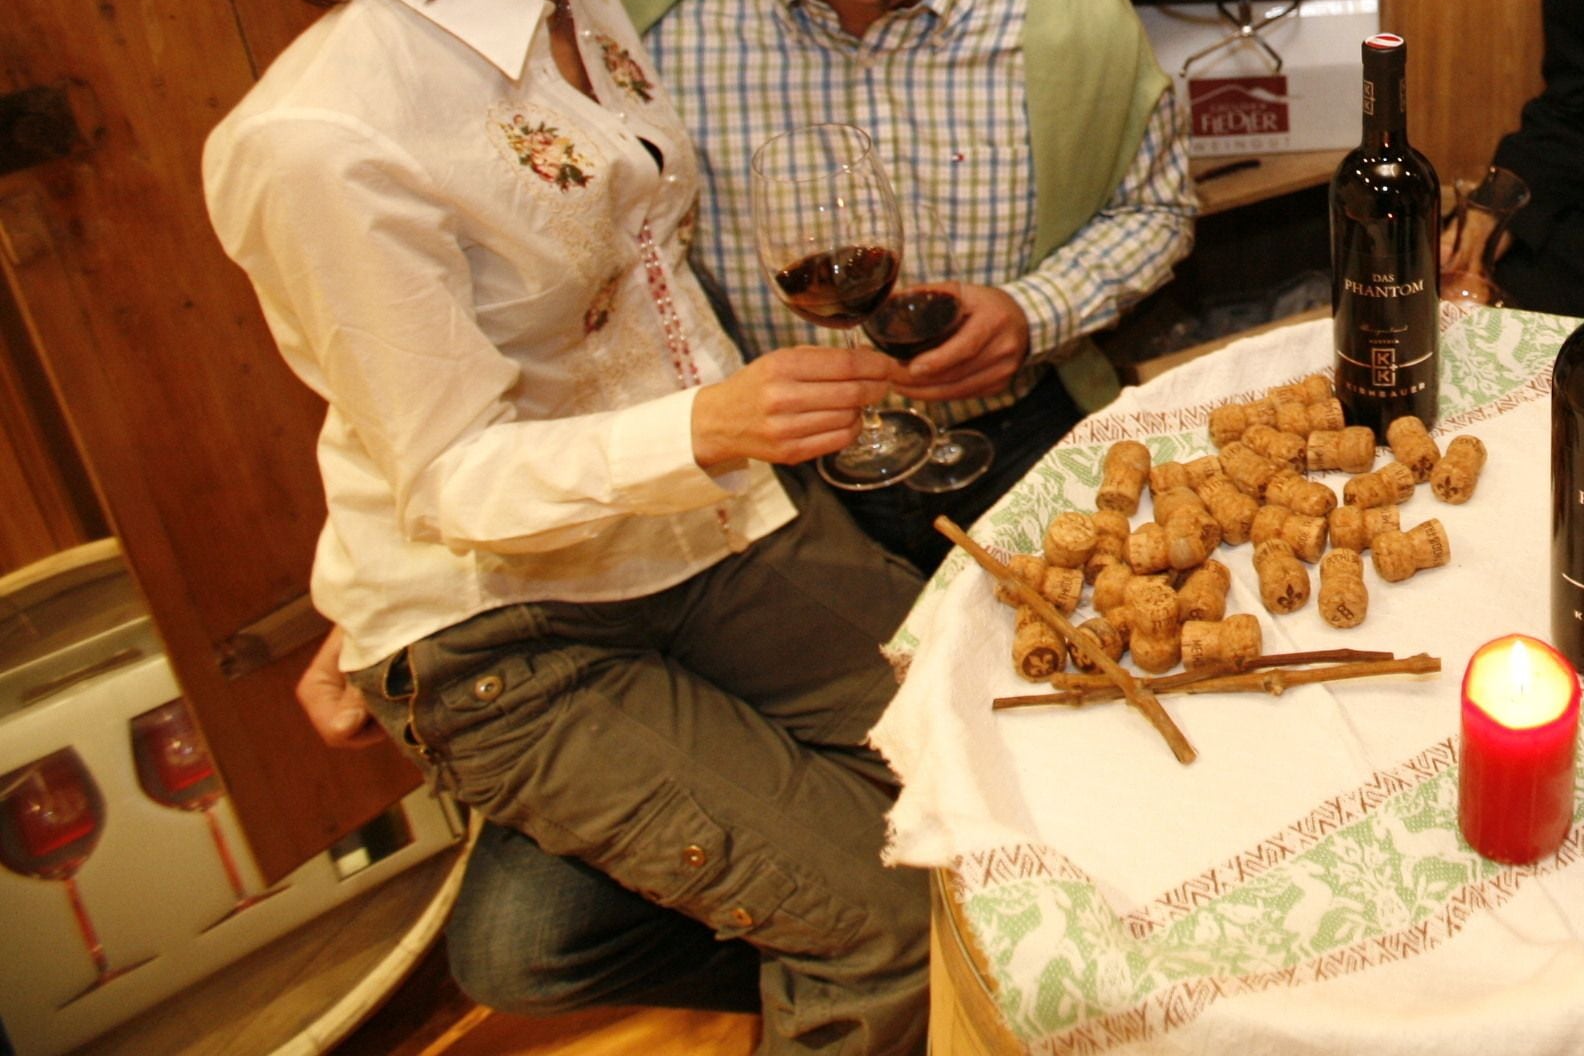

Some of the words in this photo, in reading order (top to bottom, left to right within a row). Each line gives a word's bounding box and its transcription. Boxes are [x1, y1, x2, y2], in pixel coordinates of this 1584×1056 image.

[1372, 273, 1395, 283] DAS
[1344, 277, 1424, 298] PHANTOM
[1376, 352, 1390, 365] K
[1376, 370, 1390, 383] K
